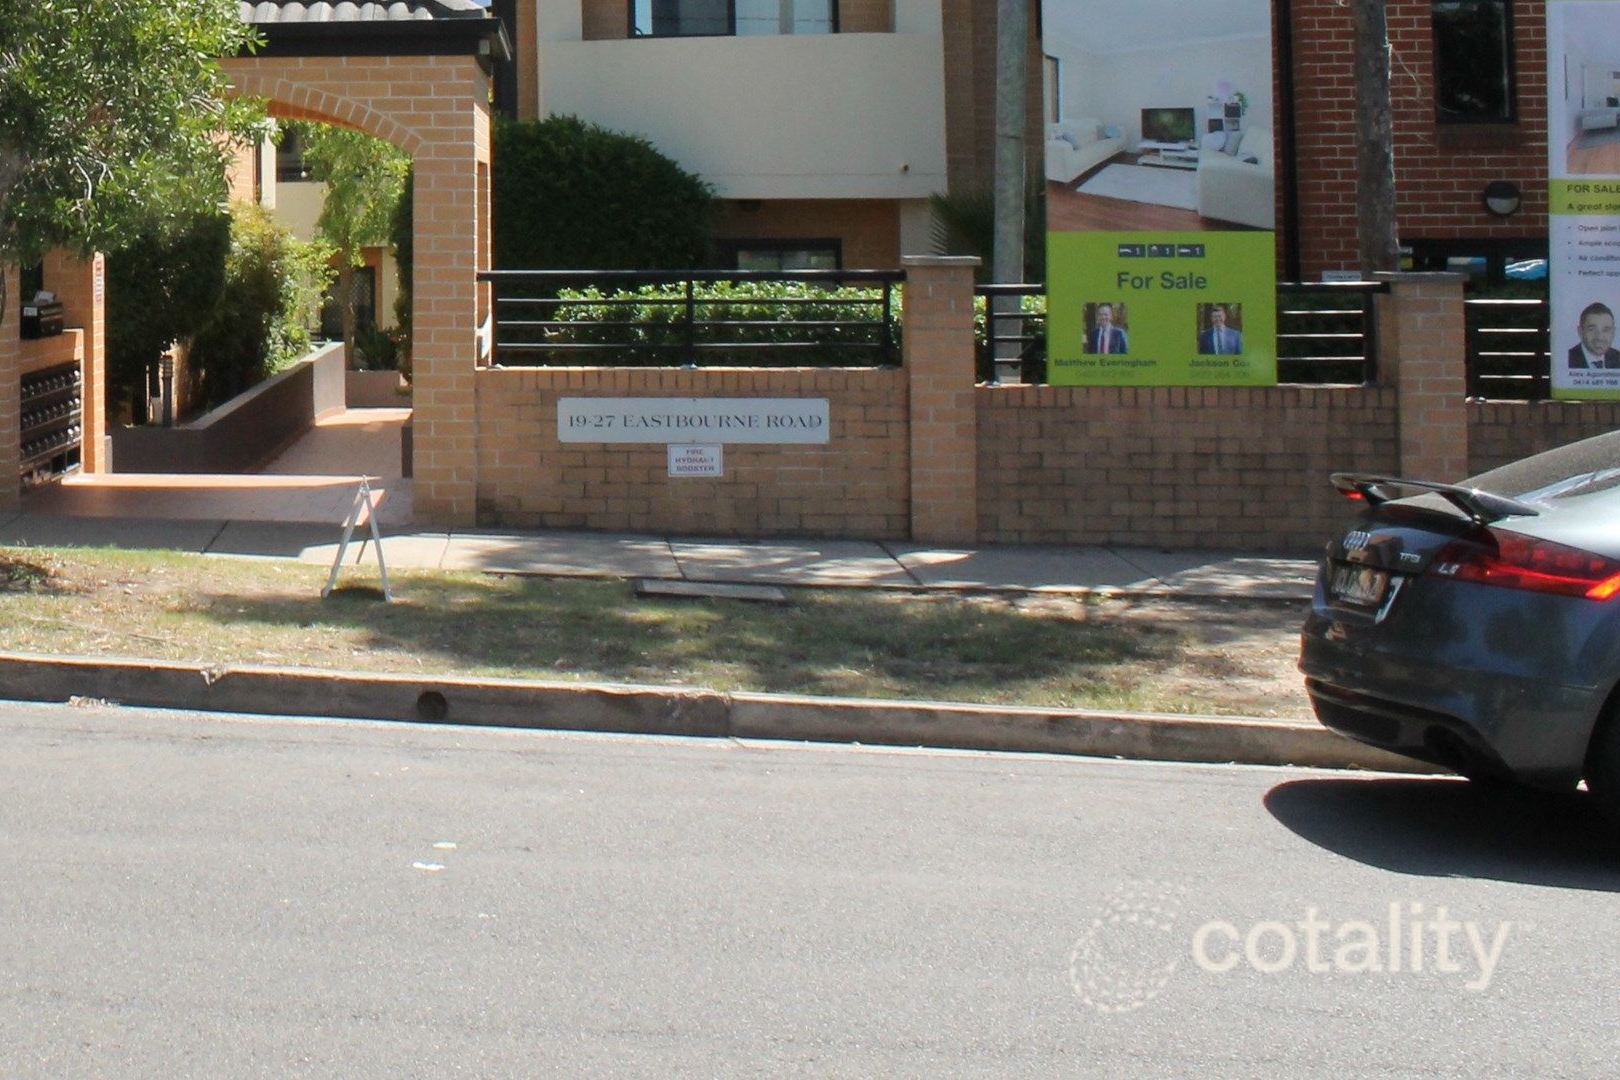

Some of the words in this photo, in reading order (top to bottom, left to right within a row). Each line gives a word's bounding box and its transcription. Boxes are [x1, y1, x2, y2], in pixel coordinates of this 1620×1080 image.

[1567, 184, 1590, 193] FOR
[1577, 203, 1602, 212] great
[1117, 272, 1153, 289] For
[1160, 272, 1208, 290] Sale
[1054, 358, 1096, 367] Matthew
[568, 414, 615, 428] 19-27
[622, 414, 761, 429] EASTBOURNE
[766, 414, 823, 429] ROAD
